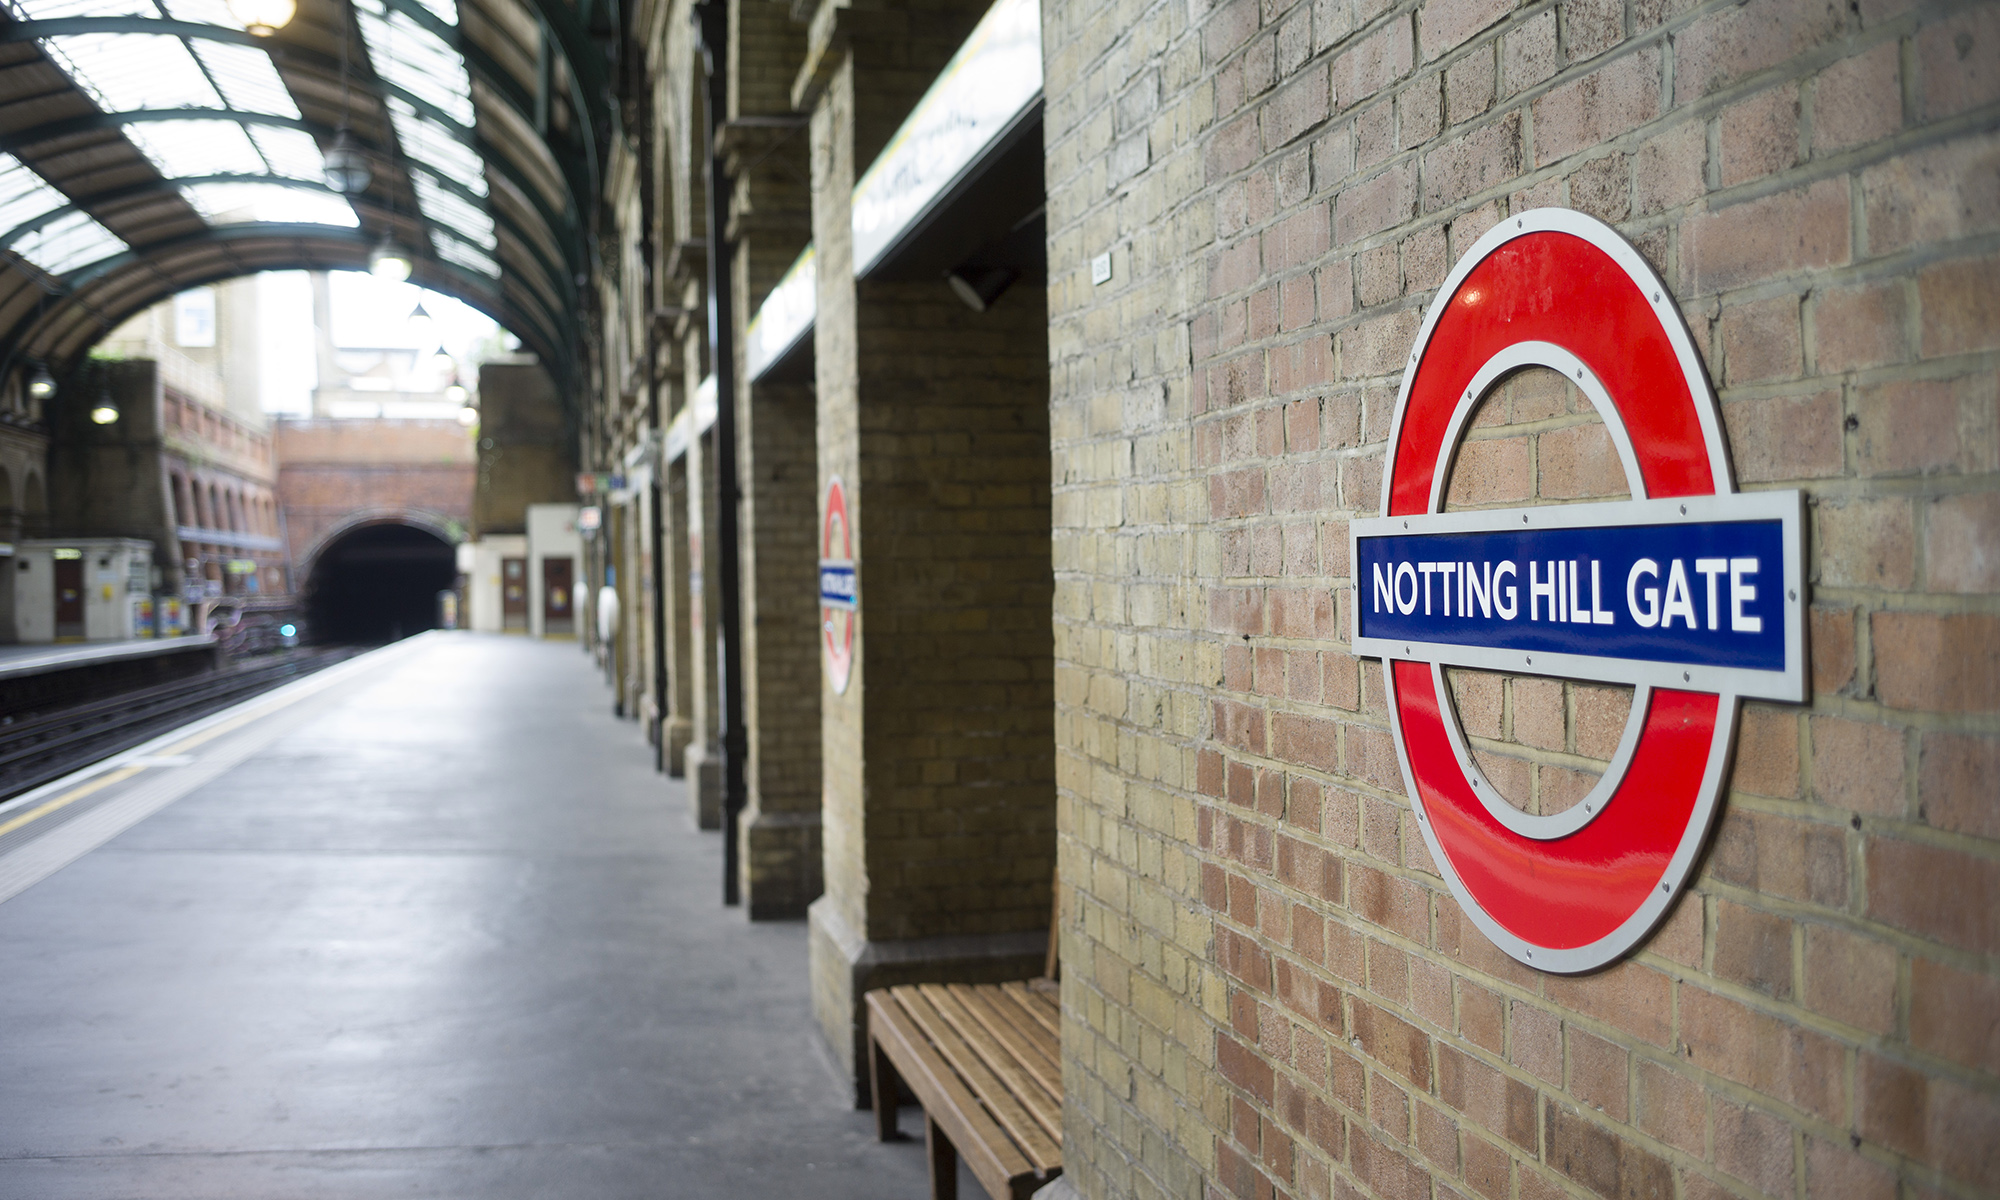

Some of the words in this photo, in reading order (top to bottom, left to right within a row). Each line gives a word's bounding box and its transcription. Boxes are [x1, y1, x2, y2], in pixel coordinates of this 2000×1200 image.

[1373, 560, 1517, 621] NOTTING
[1530, 560, 1614, 625] HILL
[1626, 558, 1762, 632] GATE
